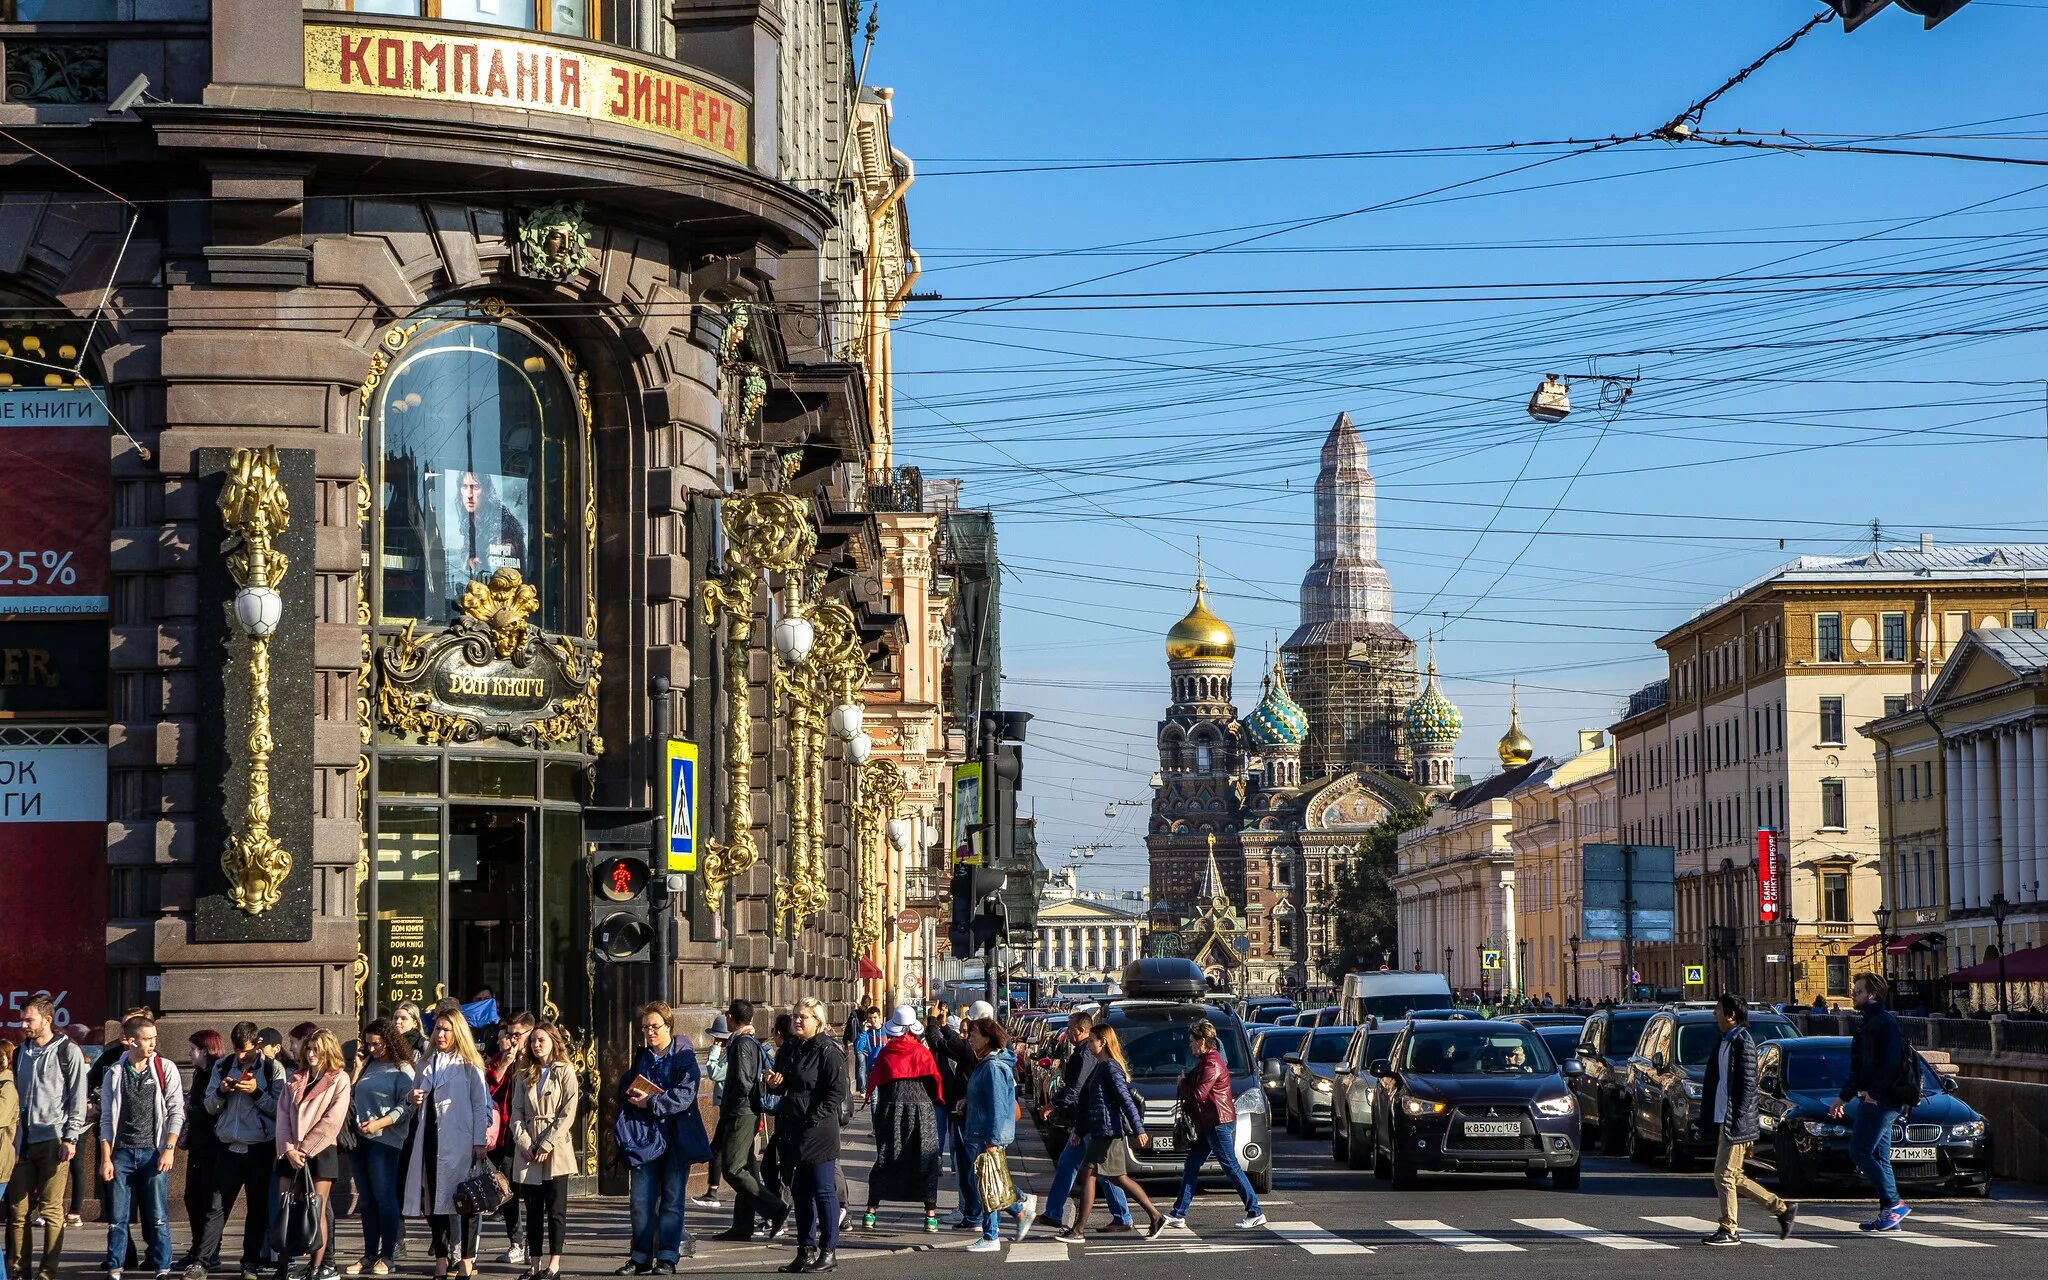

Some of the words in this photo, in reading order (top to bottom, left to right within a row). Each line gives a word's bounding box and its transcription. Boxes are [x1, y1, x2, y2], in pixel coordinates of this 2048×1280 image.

[340, 35, 581, 108] КОМПАНІЯ
[610, 67, 736, 151] ЗИНГЕРЪ
[0, 402, 15, 418] Е
[22, 402, 92, 418] КНИГИ
[5, 793, 41, 816] ГИ
[1769, 835, 1778, 900] САНКТ-ПЕТЕРБУРГ
[1763, 880, 1771, 900] БАНК
[391, 955, 404, 967] 09
[412, 955, 425, 967] 24
[391, 989, 403, 1001] 09
[411, 989, 423, 1001] 23
[1467, 1124, 1503, 1133] К850УС
[1505, 1123, 1518, 1131] 178
